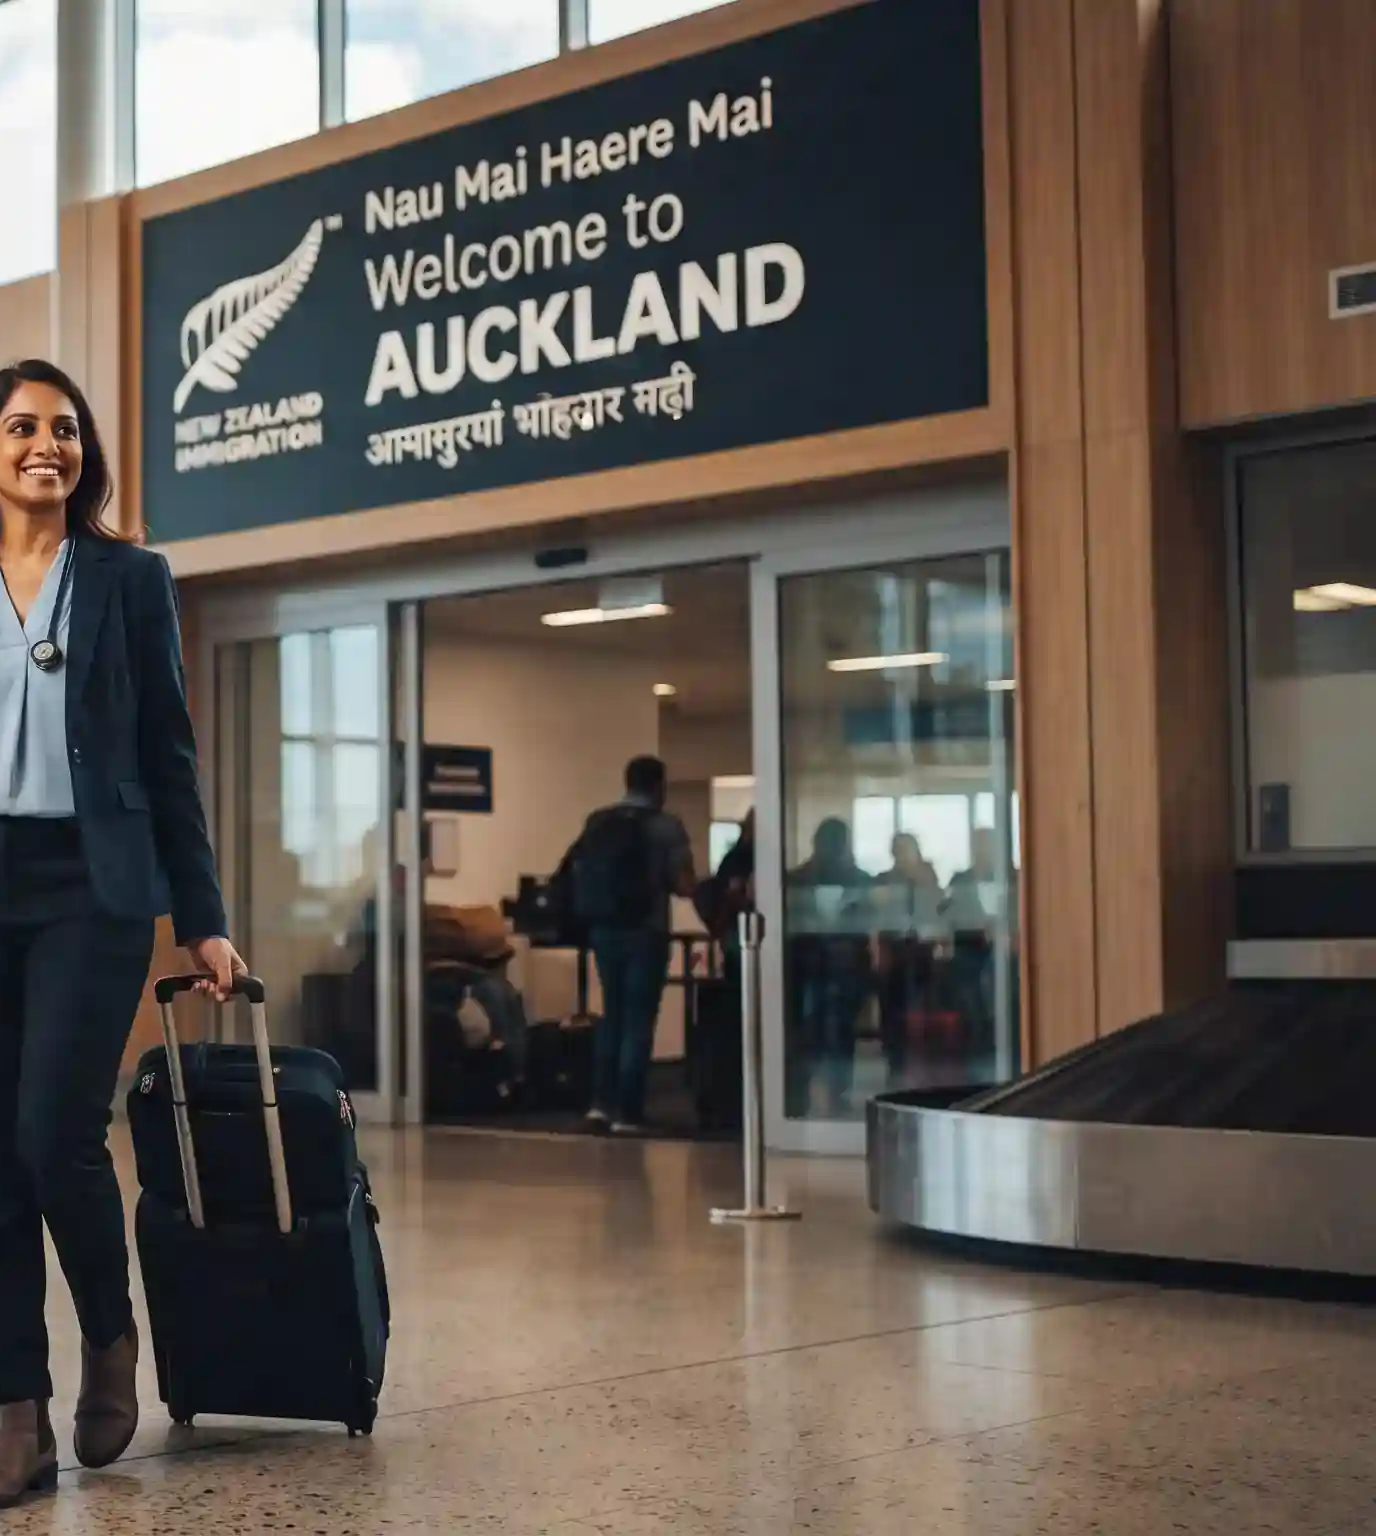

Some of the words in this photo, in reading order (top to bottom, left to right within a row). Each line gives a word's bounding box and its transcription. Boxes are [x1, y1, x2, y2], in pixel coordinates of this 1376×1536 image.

[364, 182, 444, 234] Nau
[455, 146, 528, 210] Mai
[541, 118, 674, 188] Haere
[688, 76, 773, 148] Mai
[364, 212, 608, 311] Welcome
[621, 192, 684, 250] to
[364, 242, 806, 407] AUCKLAND
